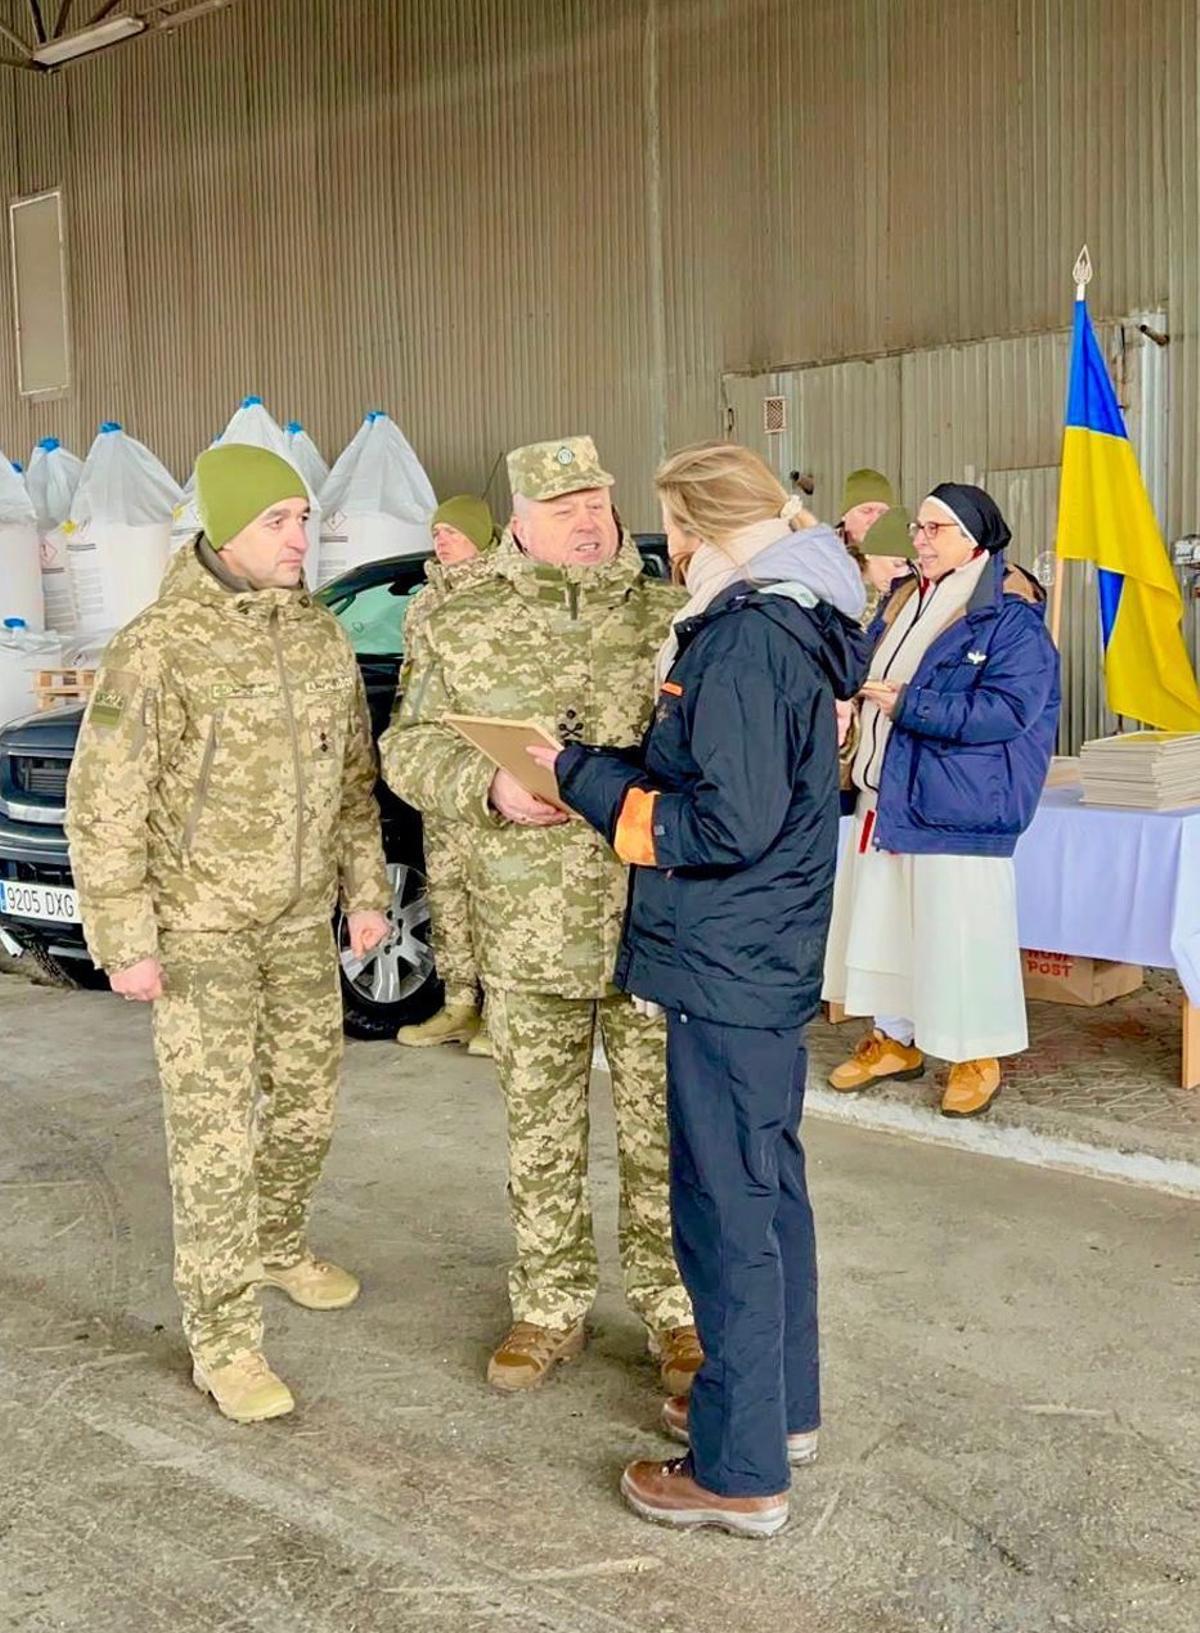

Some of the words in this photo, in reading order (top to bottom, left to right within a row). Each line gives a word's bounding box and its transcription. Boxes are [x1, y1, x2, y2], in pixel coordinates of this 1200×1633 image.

[7, 887, 41, 913] 9205
[45, 892, 74, 917] DXG
[1027, 960, 1073, 977] POST
